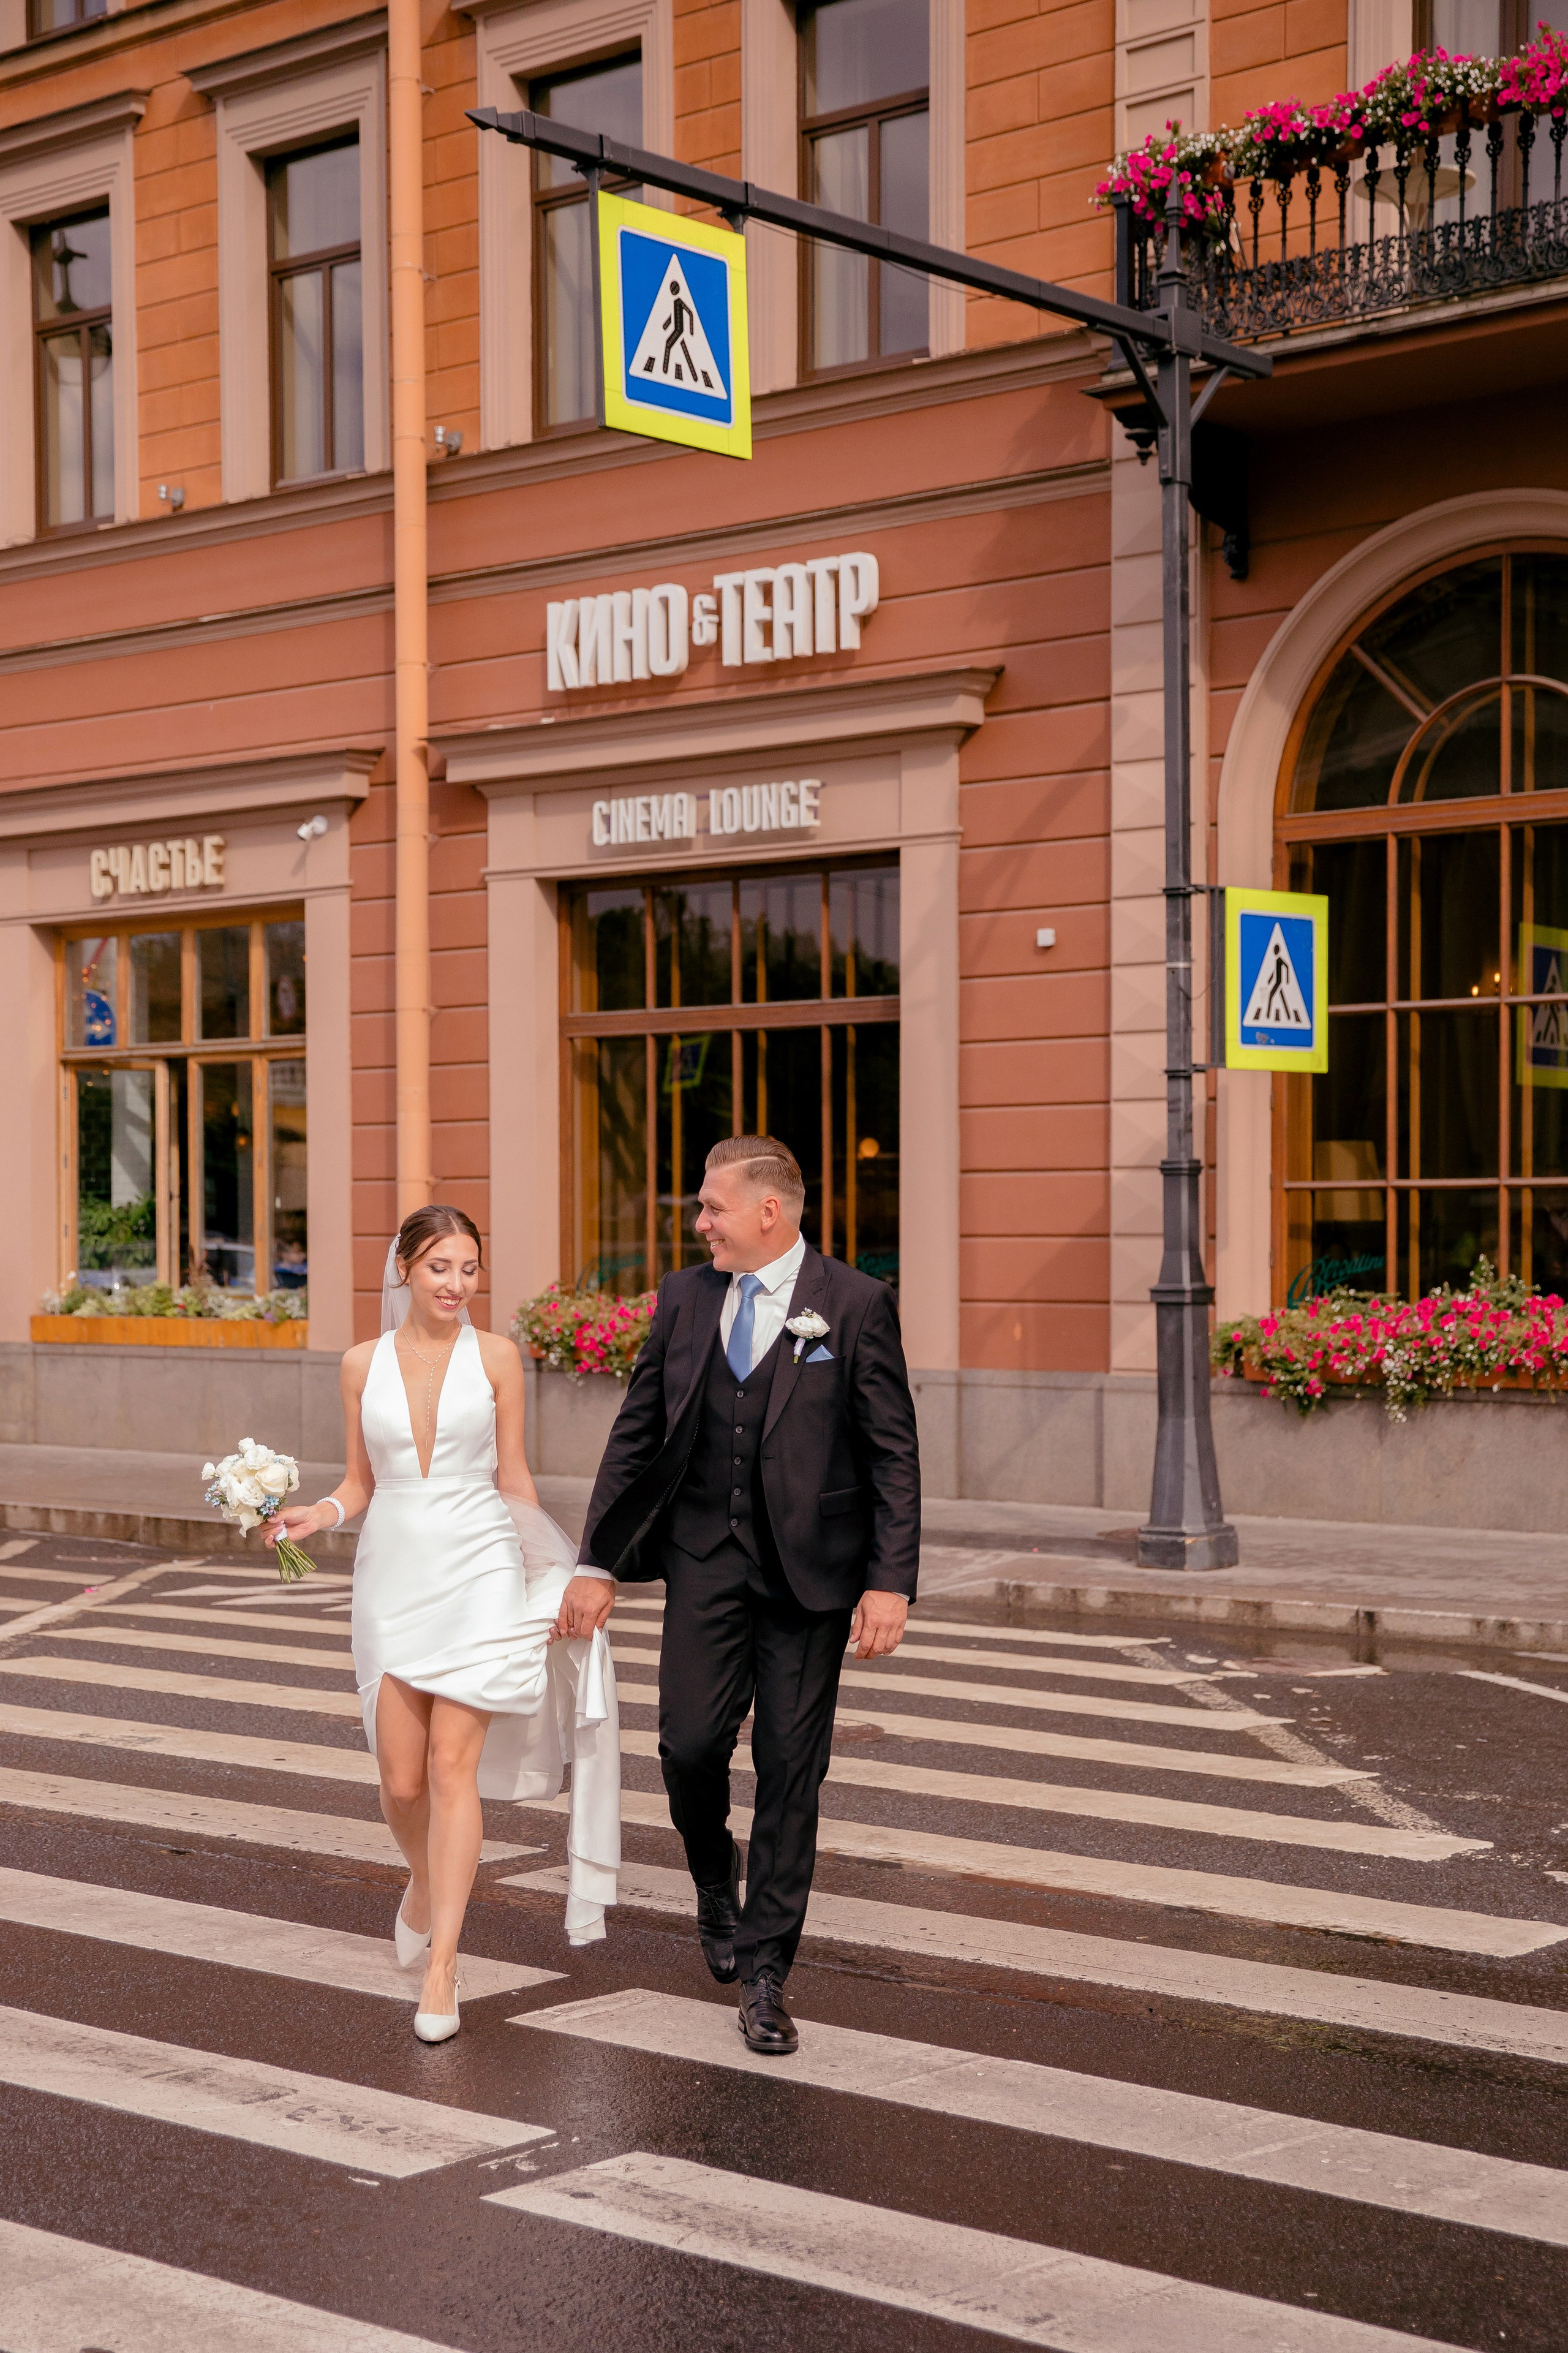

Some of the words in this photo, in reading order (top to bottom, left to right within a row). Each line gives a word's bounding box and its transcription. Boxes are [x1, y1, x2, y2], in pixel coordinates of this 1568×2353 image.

[546, 583, 689, 691] КИНО
[692, 594, 720, 646] &
[713, 551, 880, 667] ТЕАТР
[592, 792, 697, 846] CINEMA
[709, 779, 821, 836] LOUNGE
[90, 834, 225, 897] СЧАСТЬЕ
